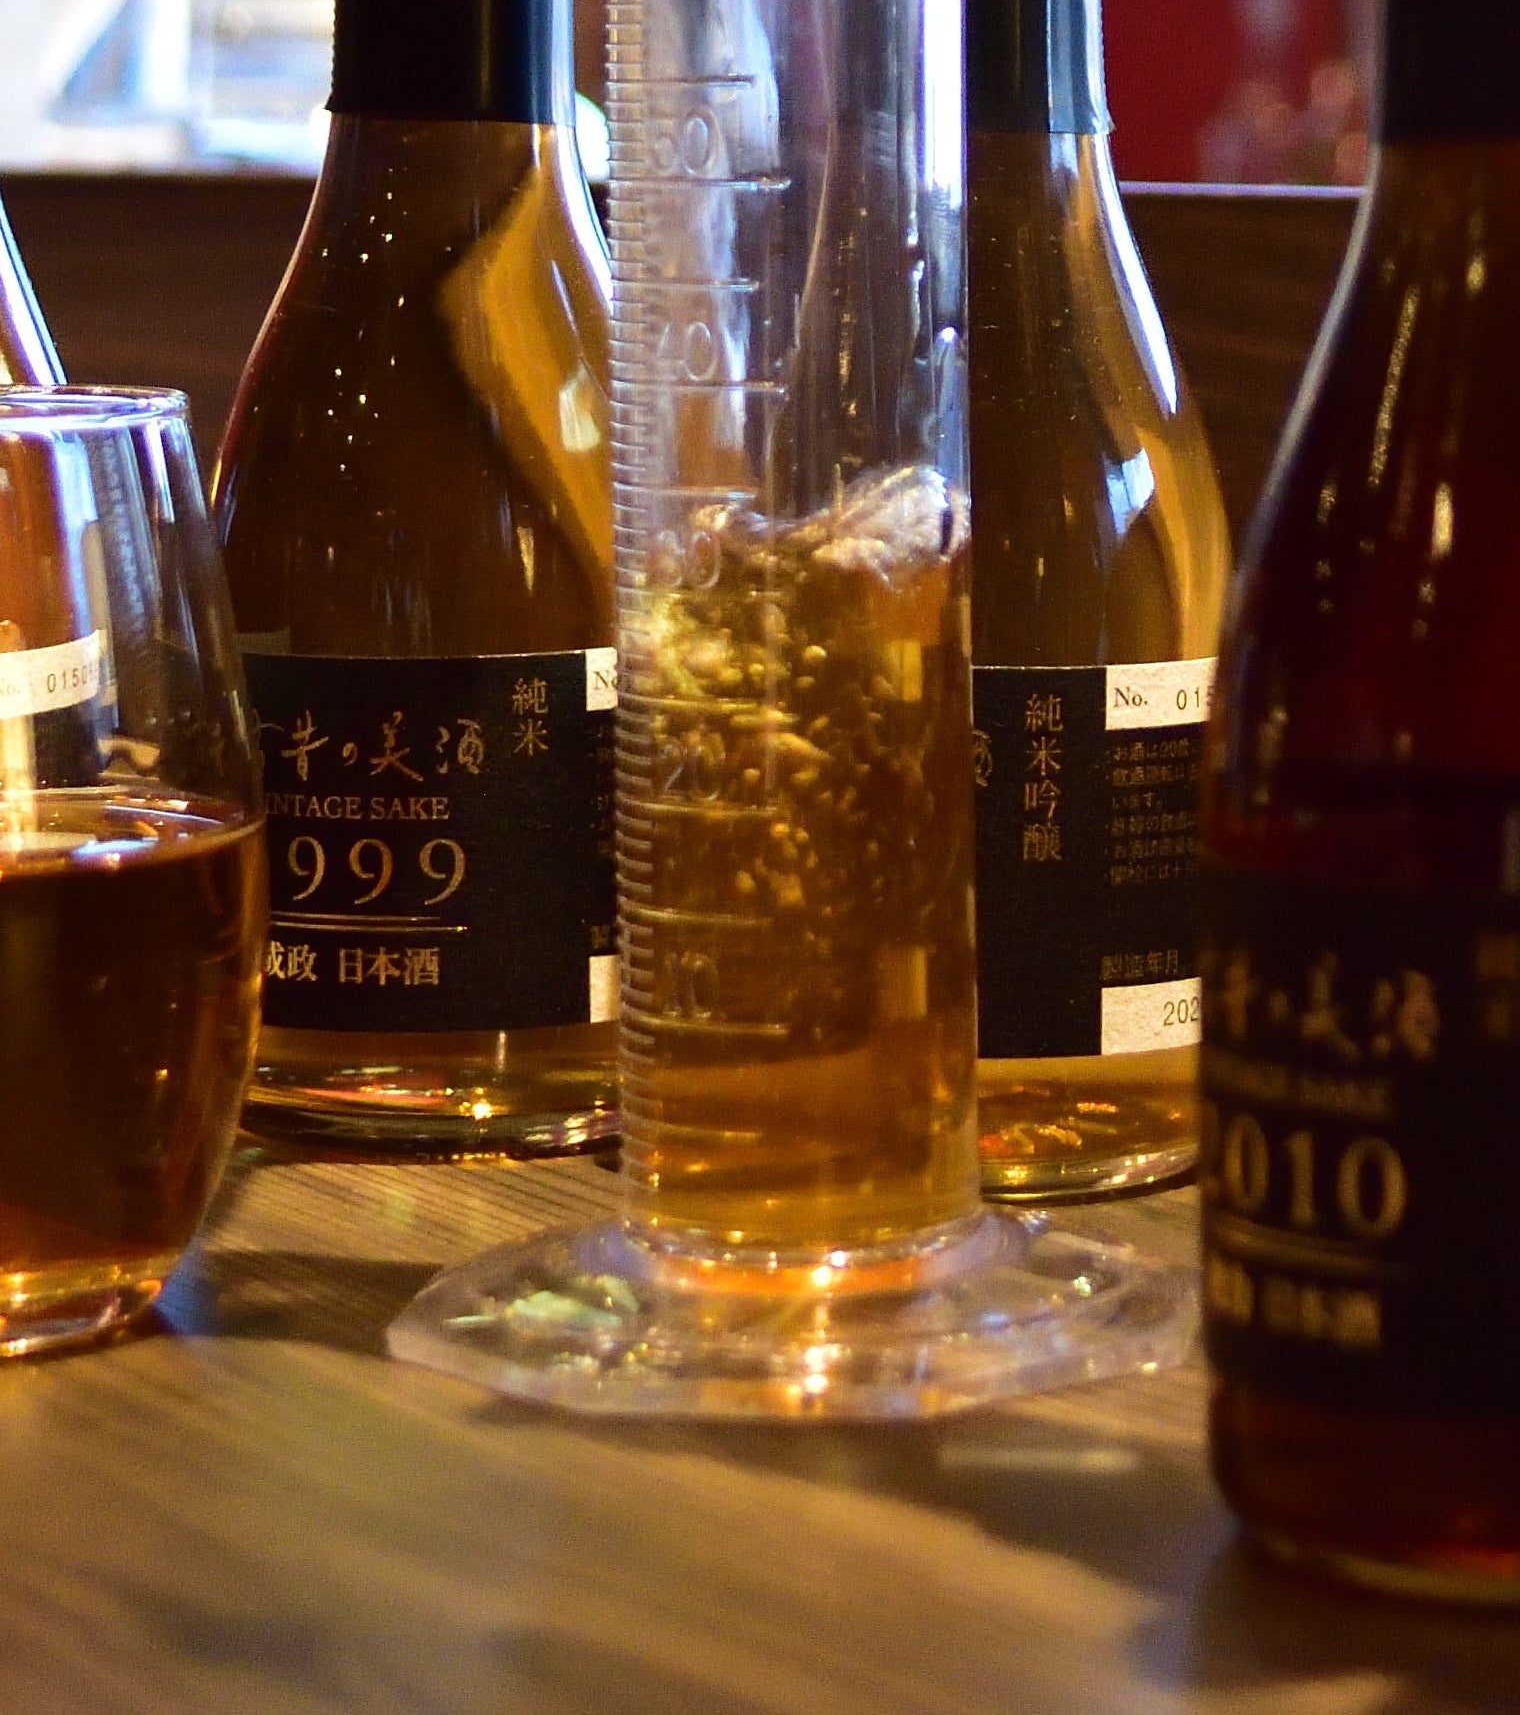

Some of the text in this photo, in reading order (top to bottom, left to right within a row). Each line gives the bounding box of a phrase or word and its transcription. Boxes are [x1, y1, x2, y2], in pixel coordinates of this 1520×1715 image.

[512, 676, 549, 757] 純米
[1113, 685, 1213, 711] No. 01
[1023, 693, 1064, 863] 純米吟醸
[369, 796, 451, 820] SAKE
[338, 945, 441, 986] 日本酒
